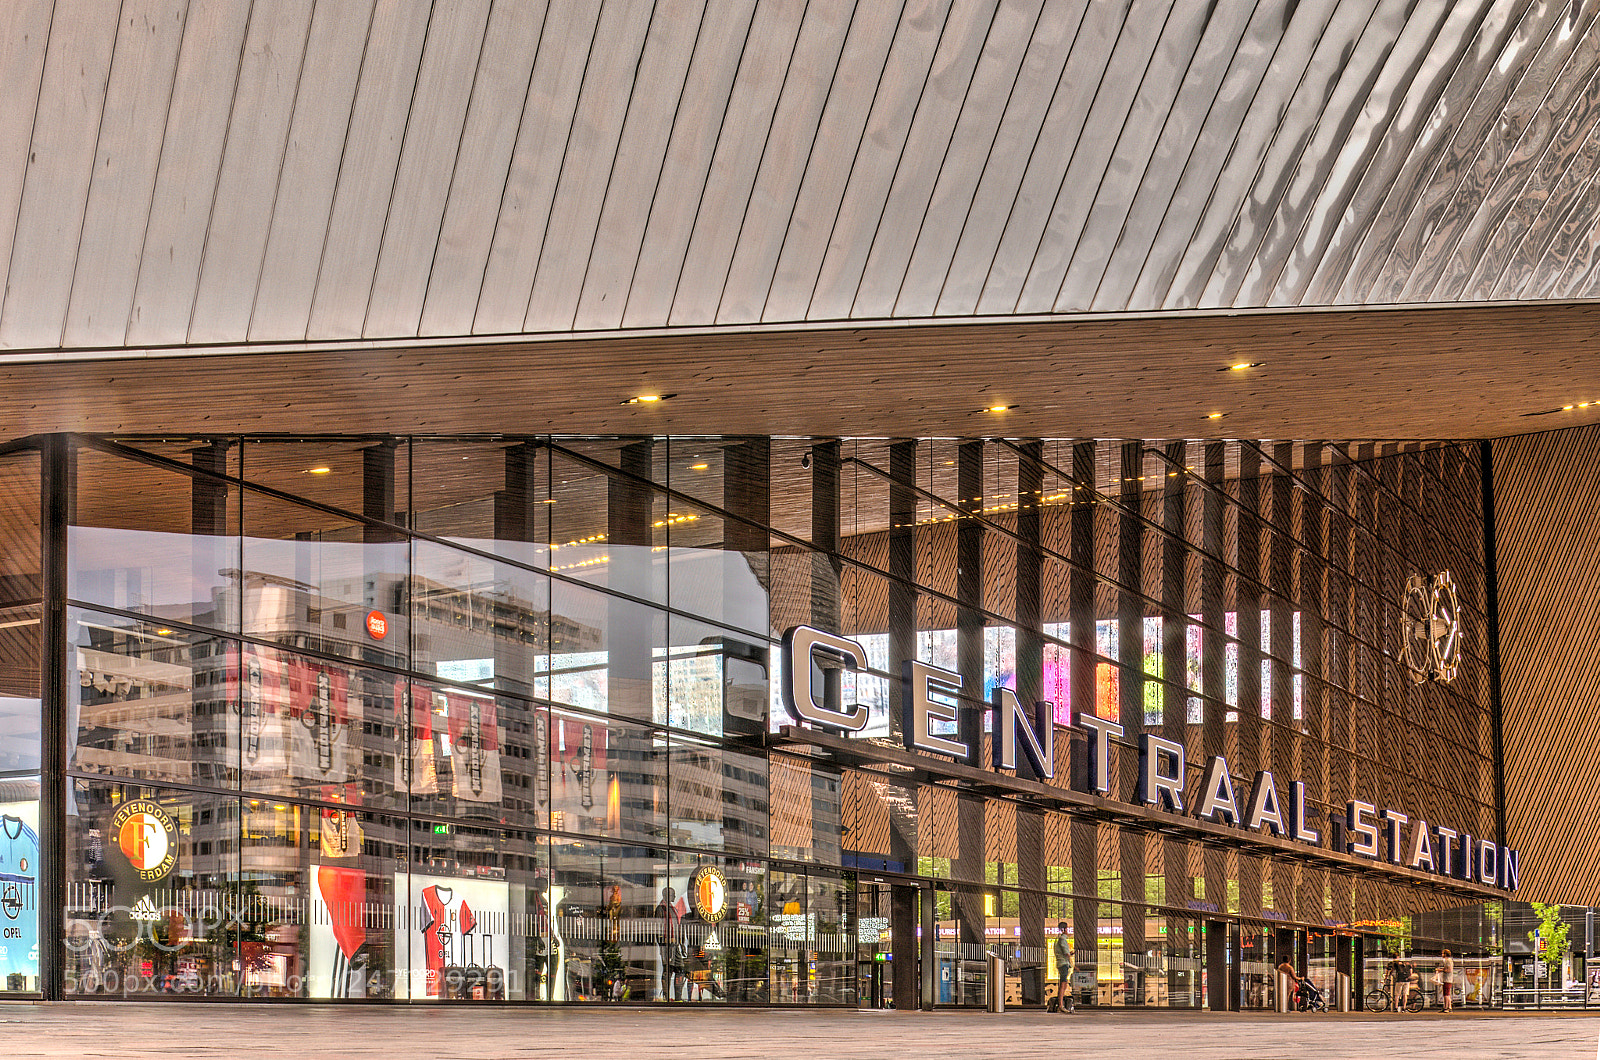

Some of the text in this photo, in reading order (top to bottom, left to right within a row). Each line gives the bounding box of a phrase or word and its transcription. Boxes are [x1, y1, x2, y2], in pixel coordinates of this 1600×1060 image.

[781, 625, 1519, 890] CENTRAAL STATION
[114, 802, 174, 833] FEYENOORD
[130, 821, 156, 861] F
[140, 854, 175, 880] ERDAM
[696, 866, 727, 887] FEYENOORD
[129, 910, 161, 921] adidas
[696, 901, 728, 922] ROTTERDAM
[3, 927, 22, 939] OPEL
